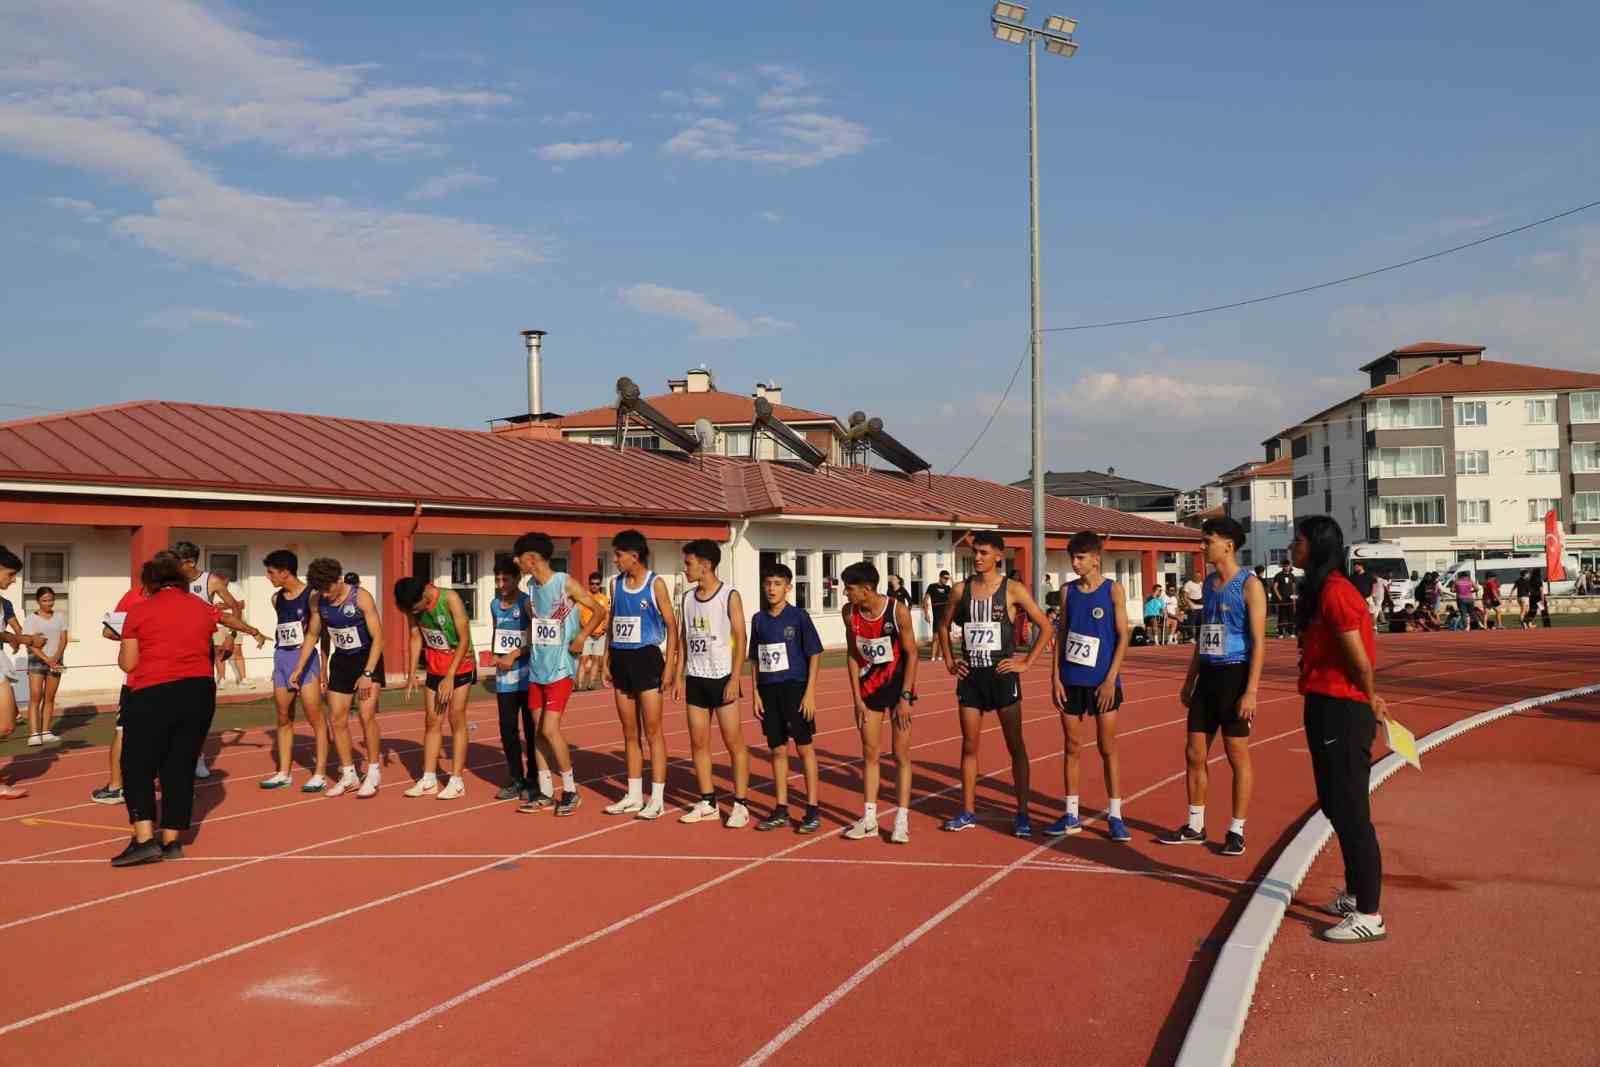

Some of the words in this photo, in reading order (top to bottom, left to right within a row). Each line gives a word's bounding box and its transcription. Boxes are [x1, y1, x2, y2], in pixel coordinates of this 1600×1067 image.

[537, 626, 557, 639] 906
[616, 624, 635, 636] 927
[969, 630, 994, 643] 772
[500, 636, 522, 648] 890
[689, 639, 707, 653] 952
[1068, 641, 1091, 658] 773
